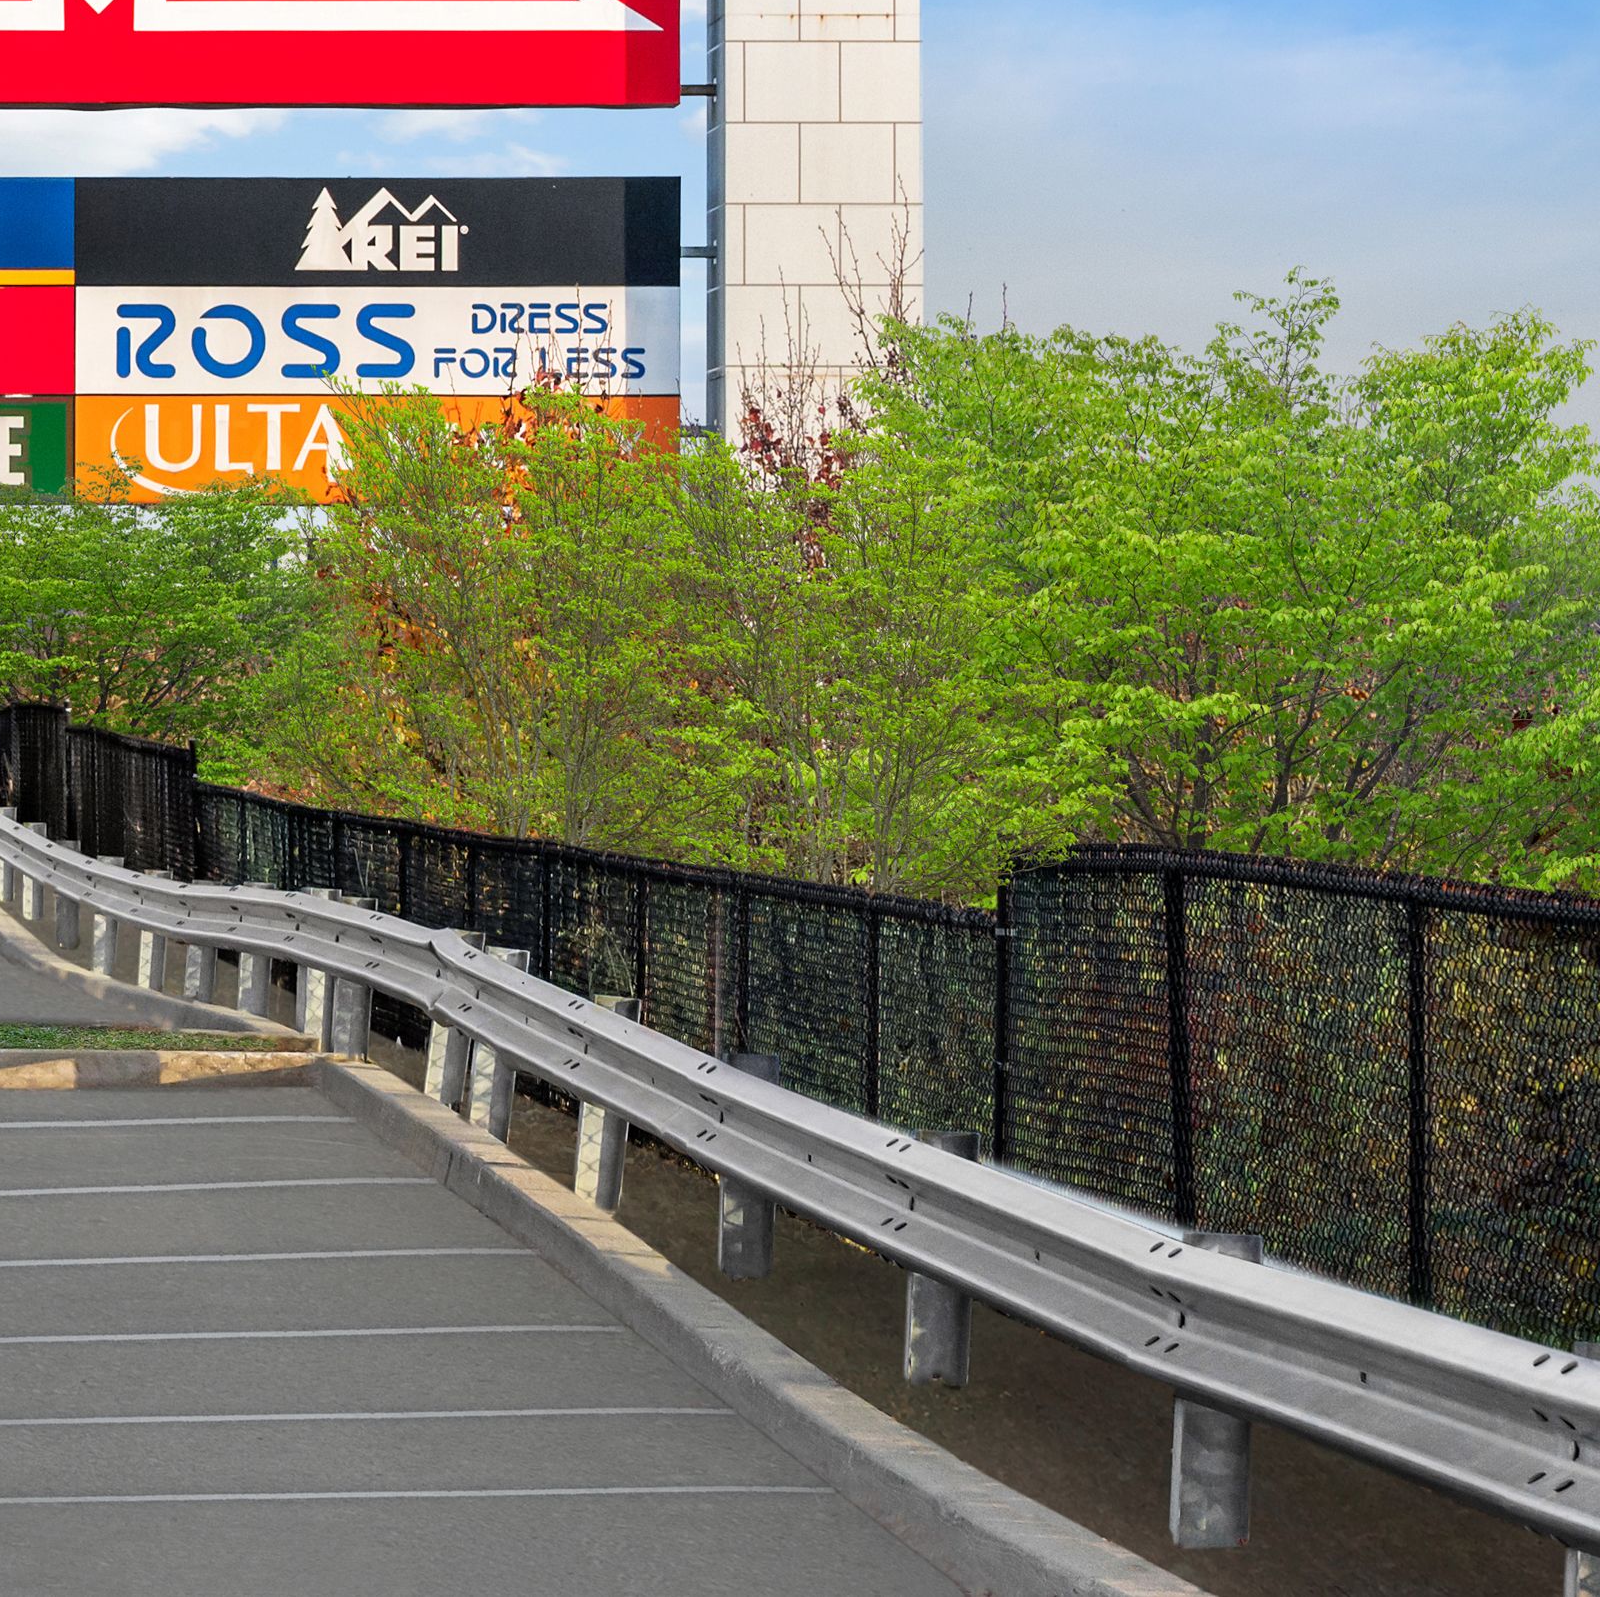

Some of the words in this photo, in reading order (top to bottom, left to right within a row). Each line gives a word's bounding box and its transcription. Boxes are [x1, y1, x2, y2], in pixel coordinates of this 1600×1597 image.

[350, 224, 459, 271] REI
[116, 303, 416, 379] ROSS
[471, 302, 608, 335] DRESS
[433, 347, 518, 379] FOR
[539, 347, 646, 379] LESS
[144, 403, 354, 481] ULTA
